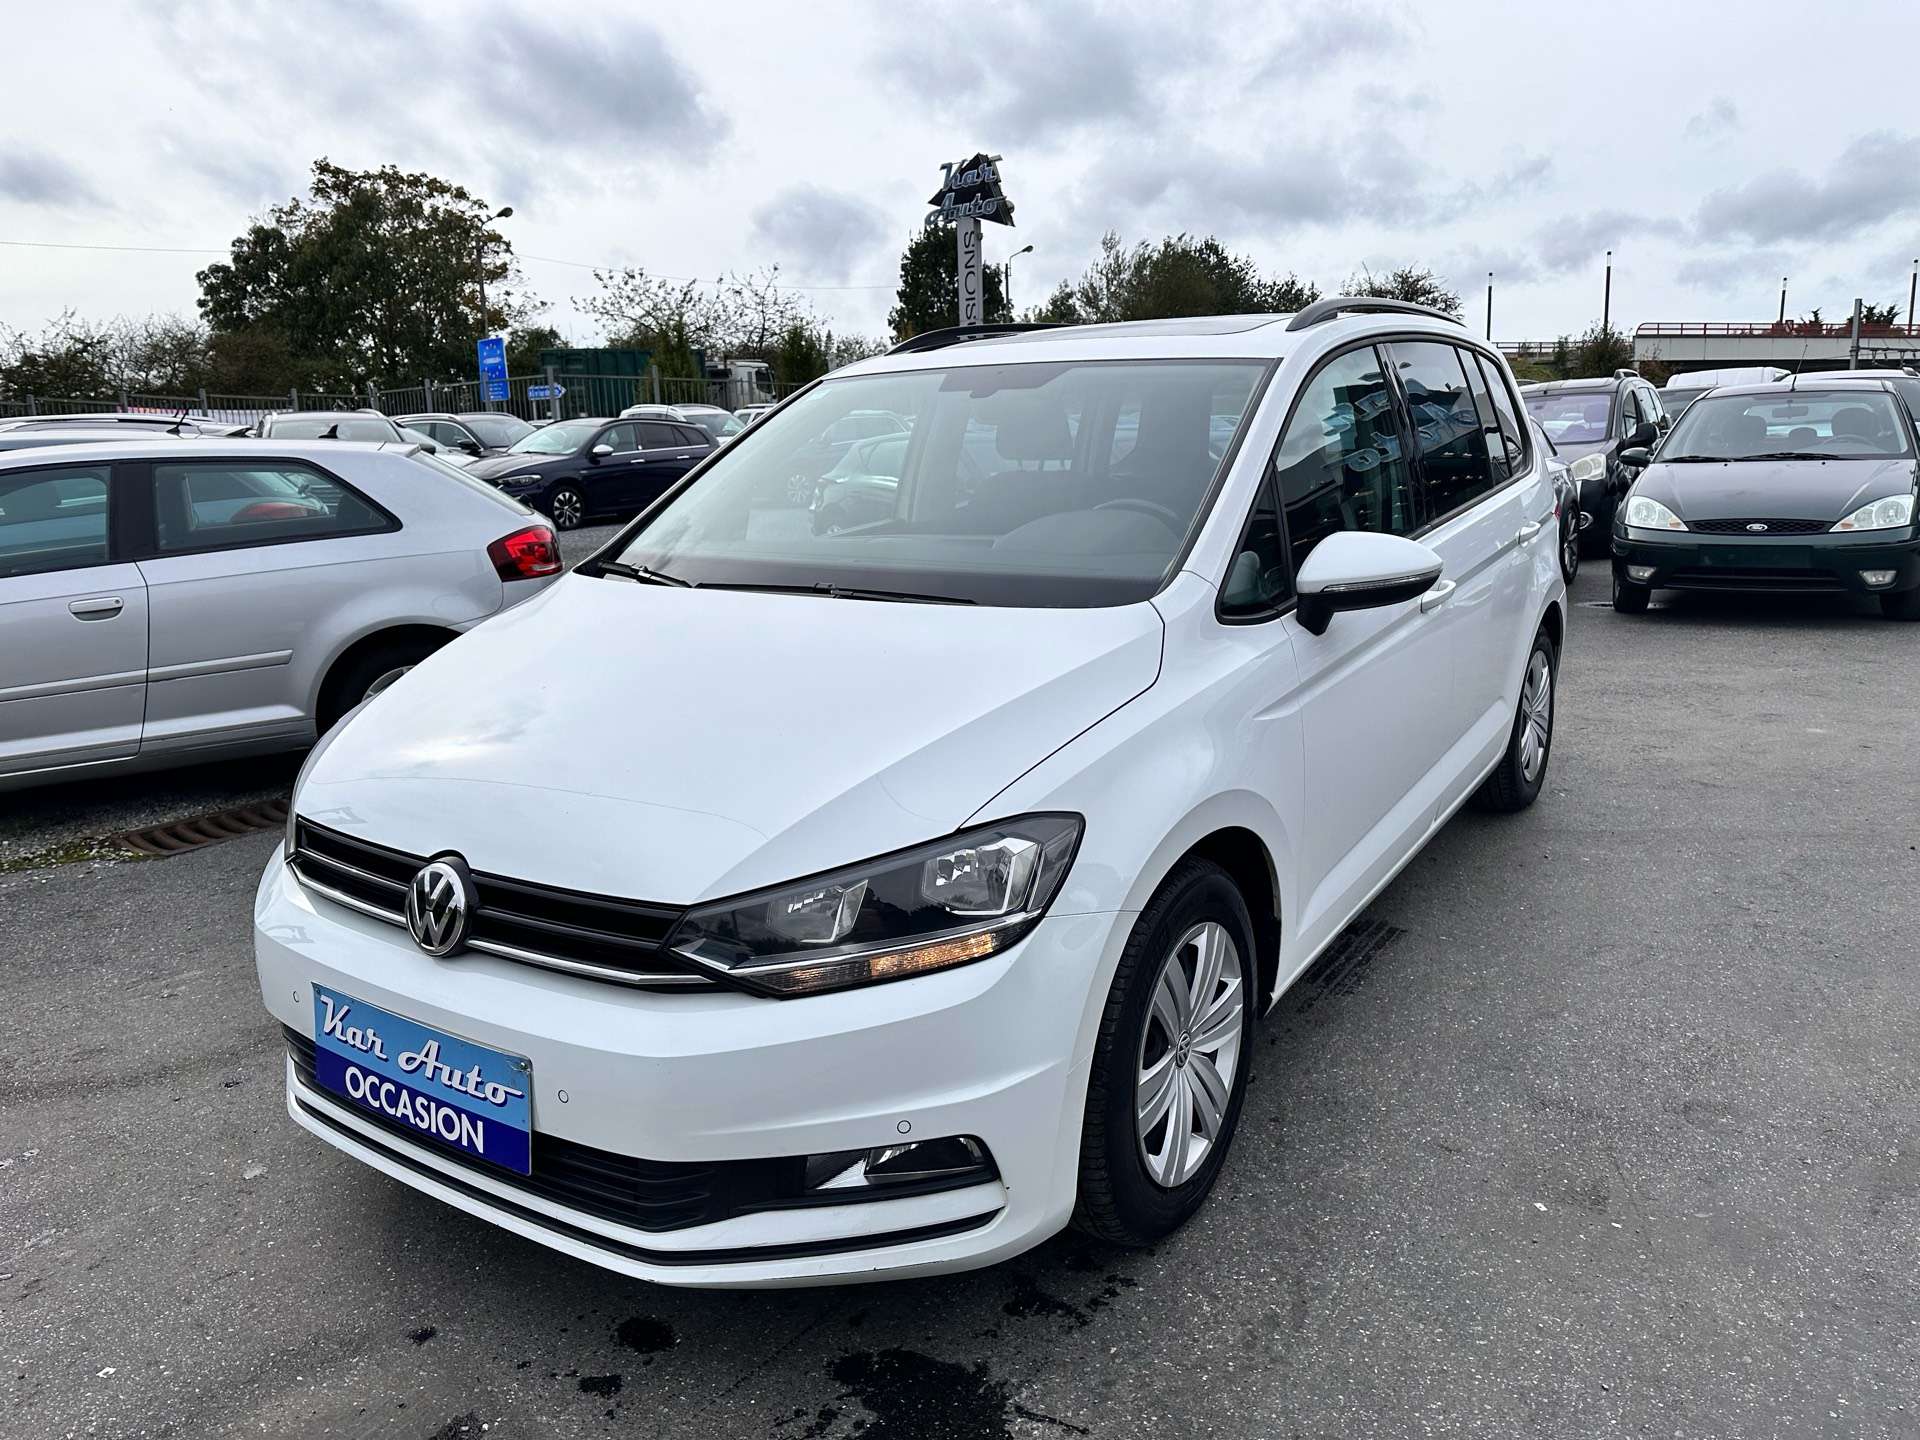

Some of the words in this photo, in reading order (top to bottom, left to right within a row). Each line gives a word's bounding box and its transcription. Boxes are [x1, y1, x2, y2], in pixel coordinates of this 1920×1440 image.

[924, 192, 1007, 227] Auto
[939, 158, 997, 192] Kar
[963, 231, 977, 326] SIONS
[320, 995, 388, 1060] Kar
[398, 1039, 523, 1104] Auto
[345, 1066, 484, 1154] OCCASION
